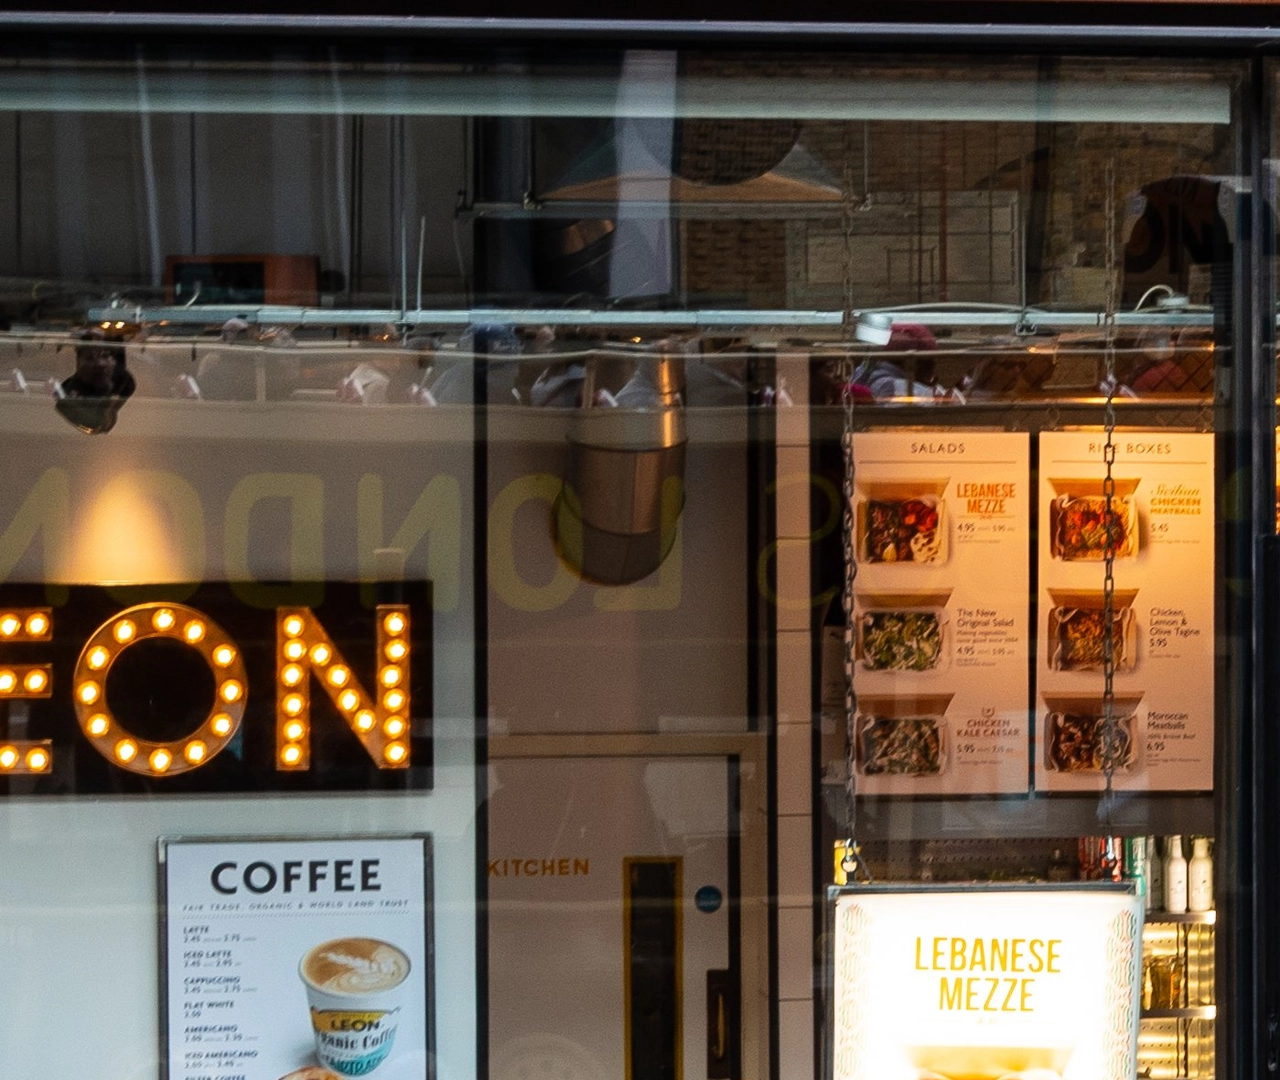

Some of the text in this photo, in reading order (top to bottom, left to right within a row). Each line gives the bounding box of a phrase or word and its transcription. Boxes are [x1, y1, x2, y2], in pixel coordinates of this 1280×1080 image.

[910, 442, 966, 454] SALADS
[1088, 443, 1172, 455] RIE BOXES
[956, 483, 1017, 498] LEBANESE
[1150, 483, 1200, 497] Sicilian
[966, 499, 1006, 515] MEZZE
[1150, 498, 1201, 506] CHICKEN
[1150, 508, 1201, 516] MEATBALLS
[488, 857, 590, 877] KITCHEN
[211, 859, 382, 895] COFFEE
[250, 901, 293, 911] ORGANIC
[309, 900, 343, 909] WORLD
[348, 900, 374, 909] LAND
[380, 899, 409, 908] TRUST
[183, 925, 210, 934] LATTE
[914, 936, 1062, 973] LEBANESE
[938, 976, 1036, 1012] MEZZE
